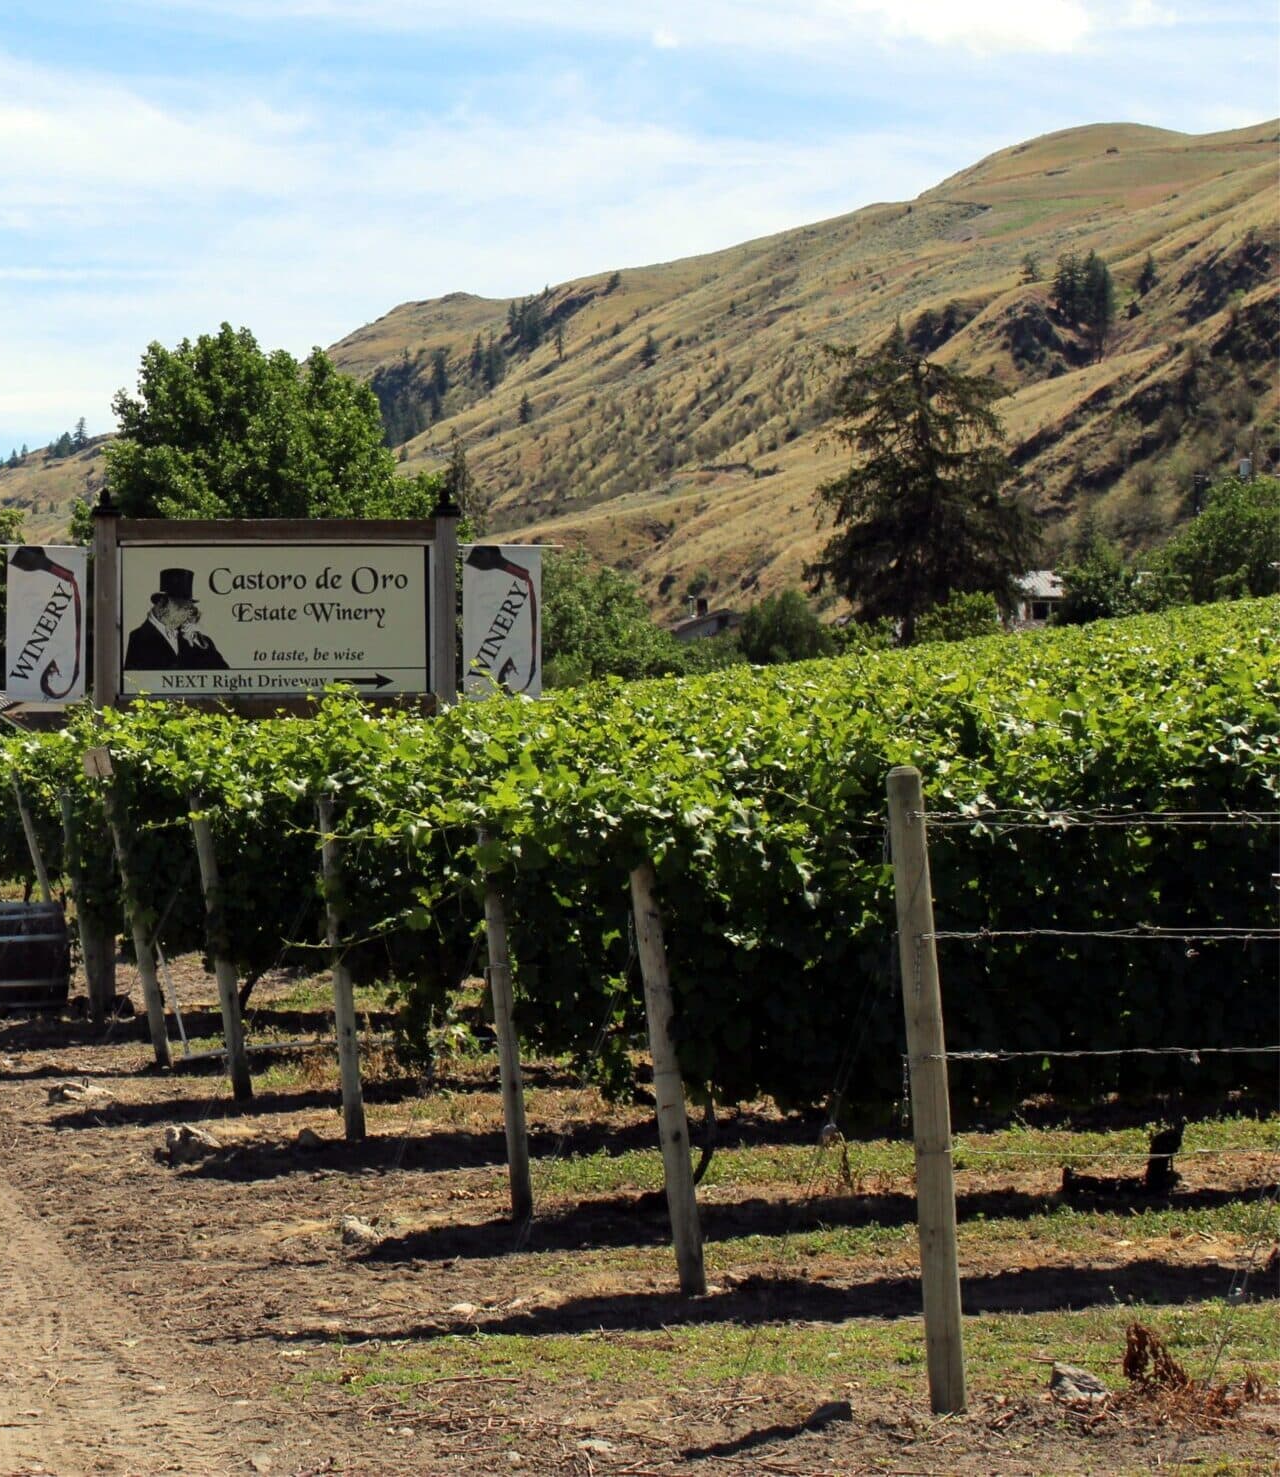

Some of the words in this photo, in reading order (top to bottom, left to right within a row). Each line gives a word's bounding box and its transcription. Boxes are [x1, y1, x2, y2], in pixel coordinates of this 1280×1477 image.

[208, 567, 307, 595] Castoro
[315, 566, 342, 590] de
[351, 566, 408, 595] Oro
[232, 603, 297, 623] Estate
[303, 602, 386, 628] Winery
[9, 582, 73, 680] WINERY
[467, 581, 529, 678] WINERY
[253, 650, 267, 662] to
[271, 649, 309, 662] taste,
[313, 648, 329, 661] be
[334, 650, 365, 661] wise
[161, 675, 209, 688] NEXT
[212, 674, 253, 691] Right
[258, 674, 328, 690] Driveway
